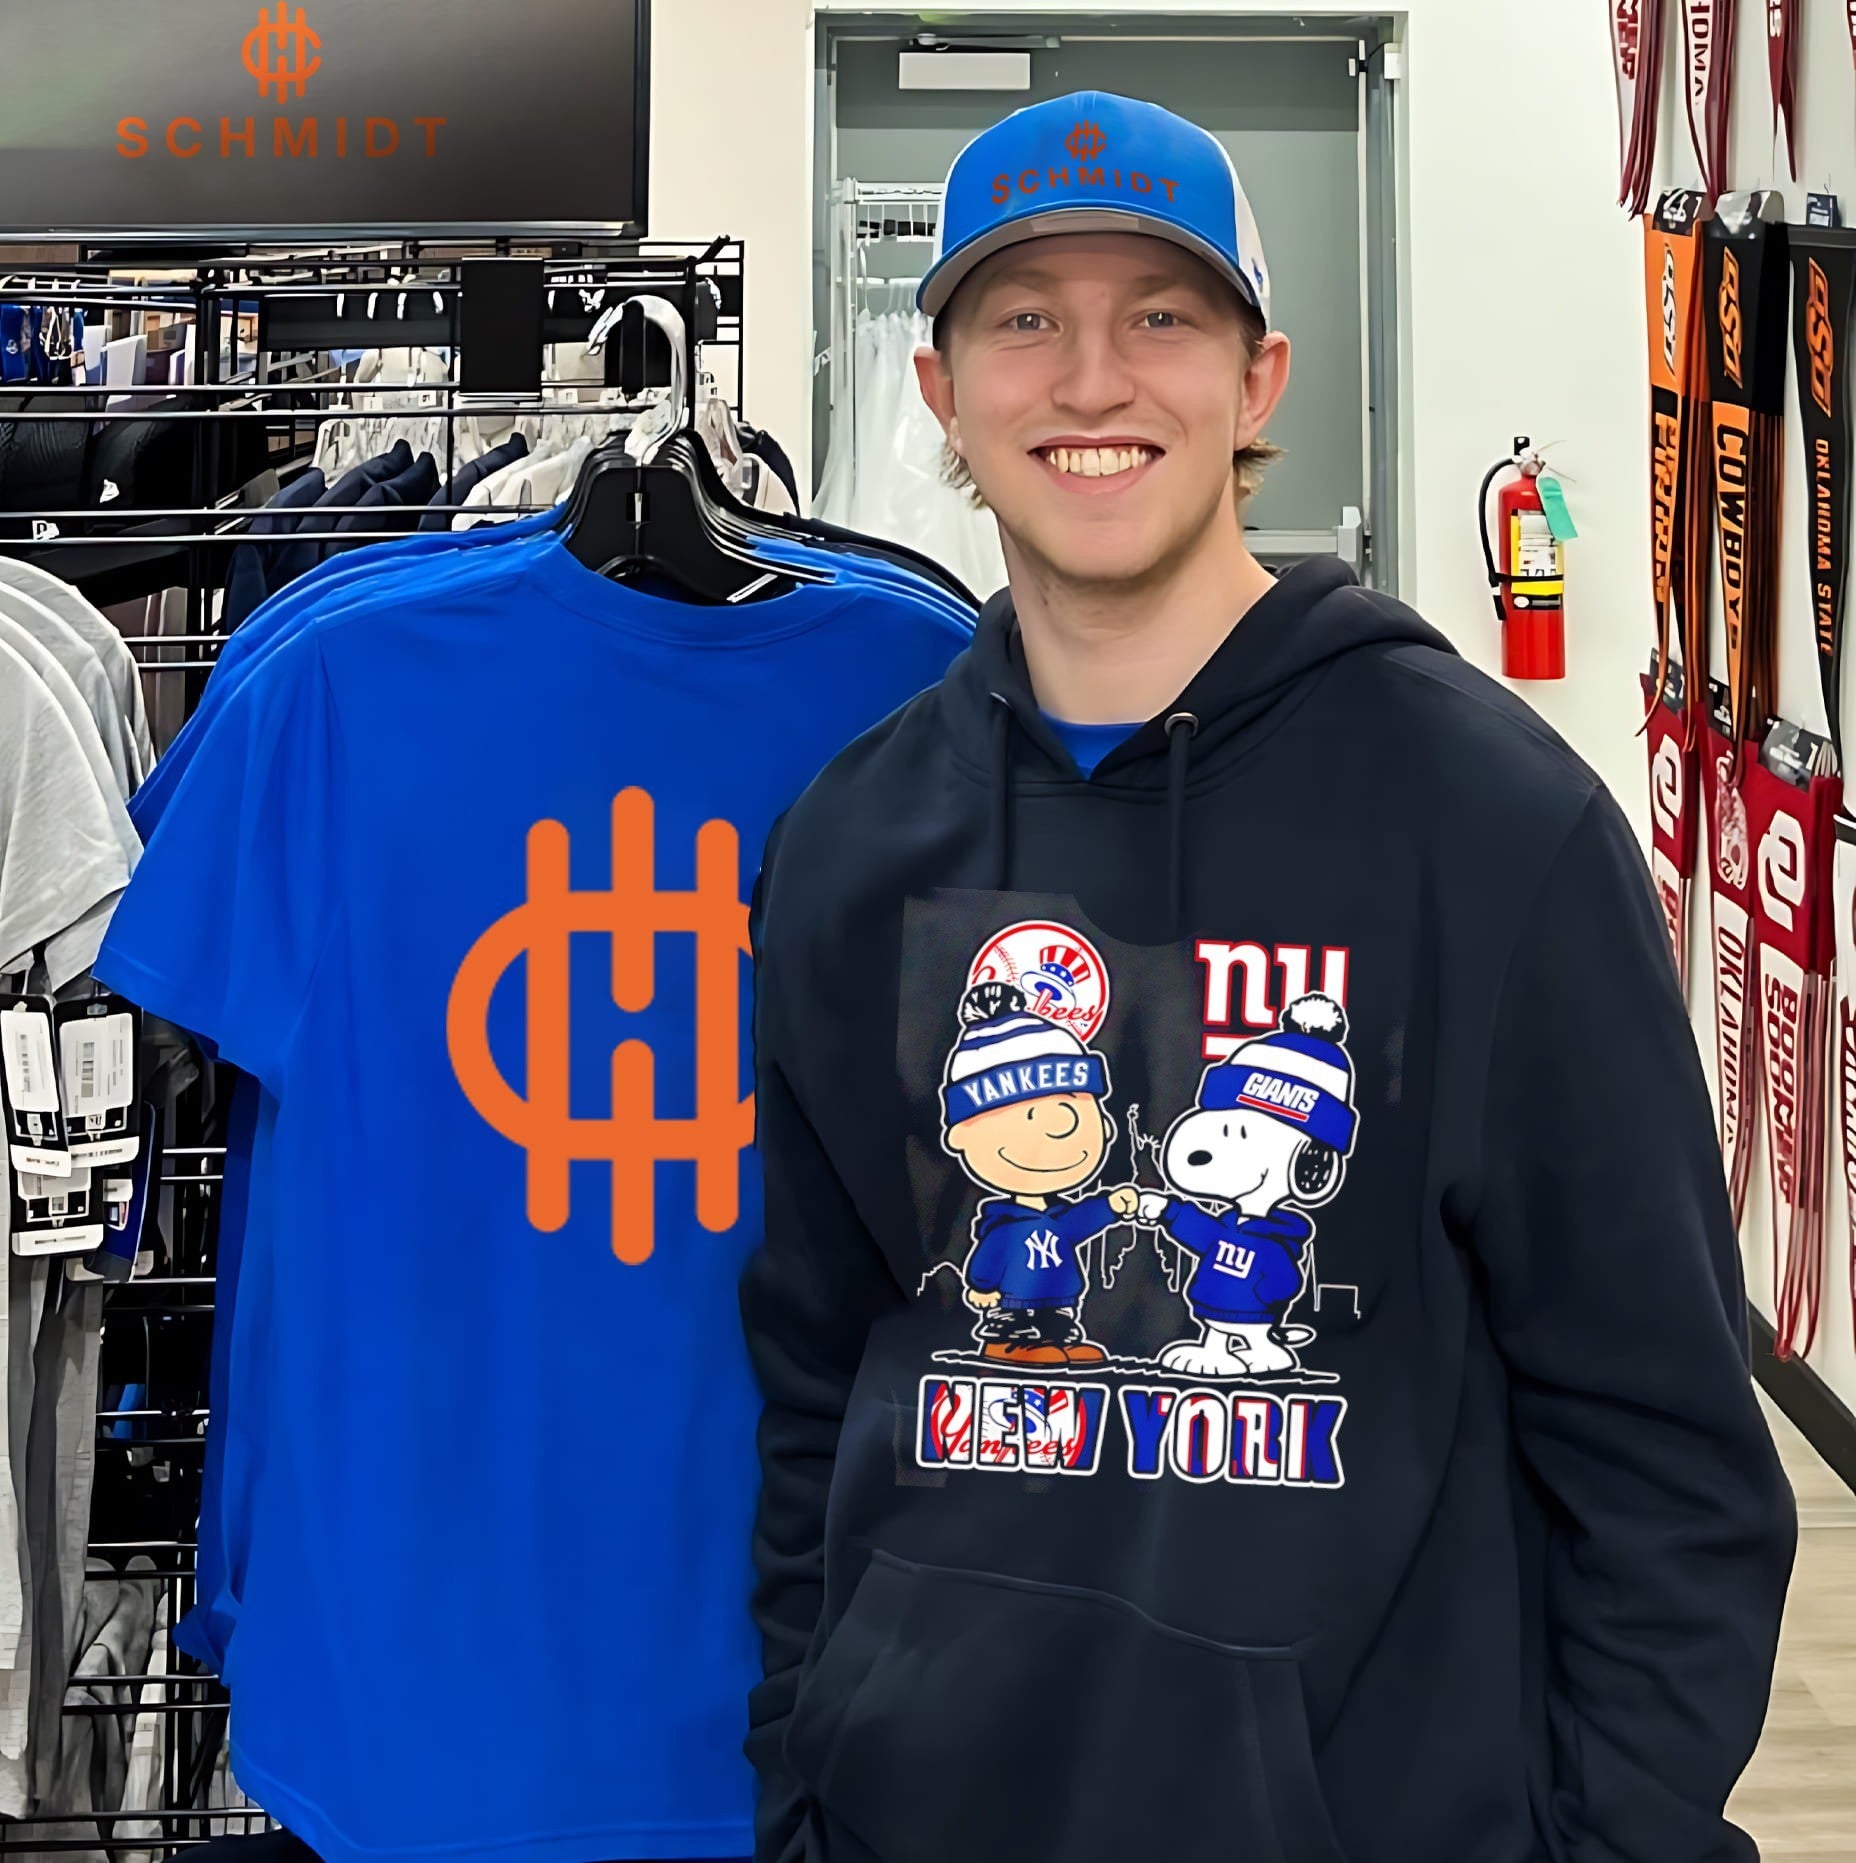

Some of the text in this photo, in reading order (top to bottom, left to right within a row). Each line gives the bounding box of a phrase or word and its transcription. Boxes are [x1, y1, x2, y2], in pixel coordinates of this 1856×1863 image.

[115, 116, 449, 159] SCHMIDT
[991, 166, 1180, 205] SCHMIDT
[1815, 438, 1832, 570] OKLAHOMA
[1718, 926, 1744, 1144] OKLAHOMA
[963, 1062, 1089, 1107] YANKEES
[1242, 1072, 1320, 1113] GIANTS
[916, 1375, 1348, 1488] NEW YORK
